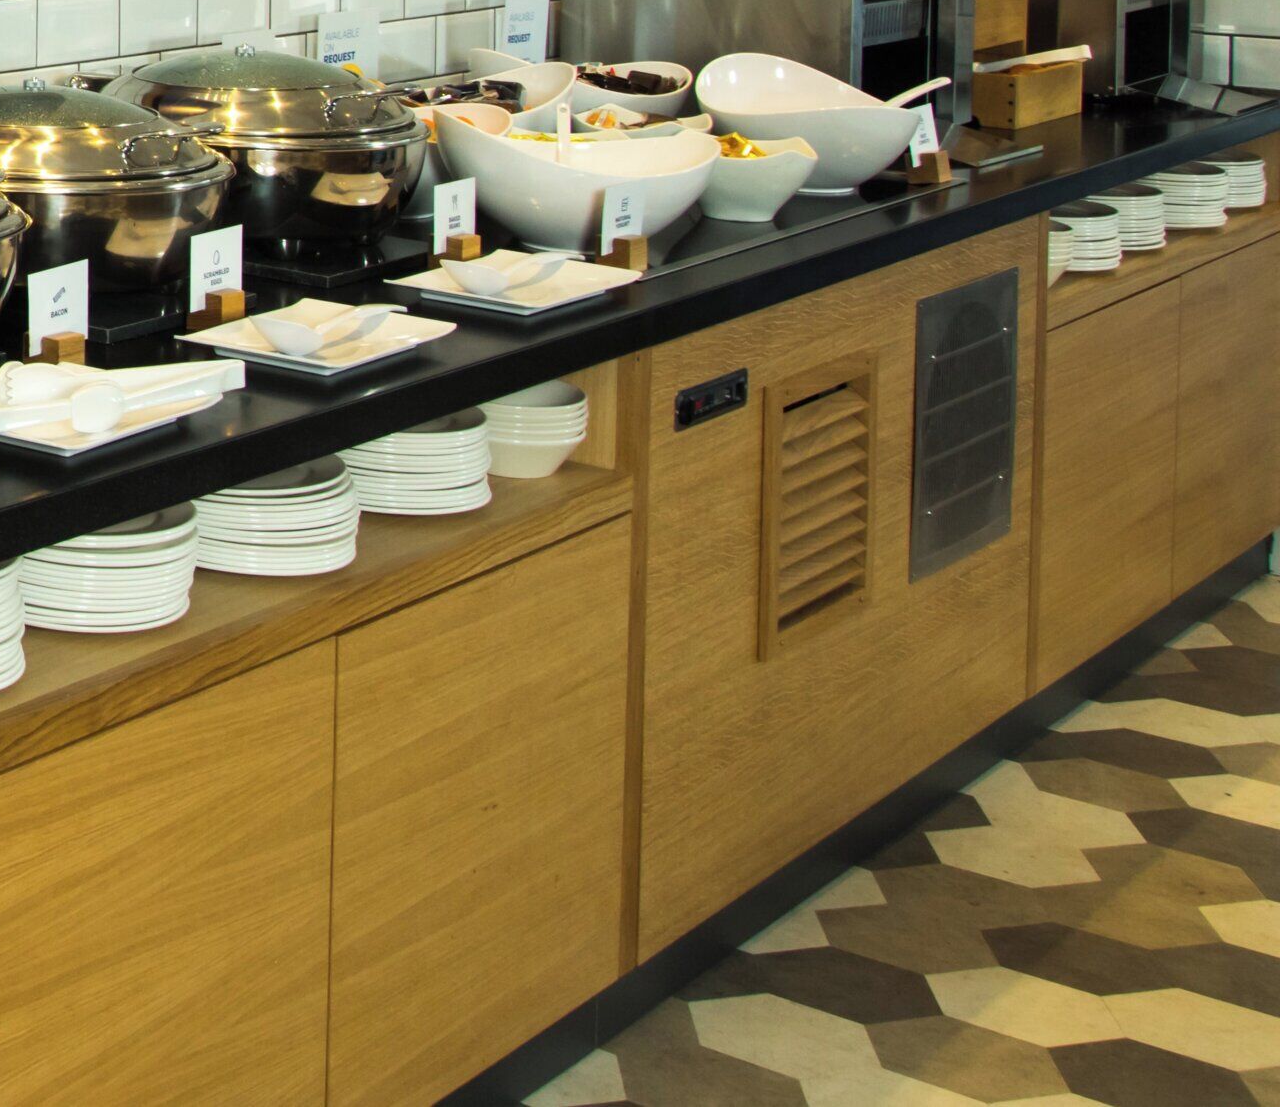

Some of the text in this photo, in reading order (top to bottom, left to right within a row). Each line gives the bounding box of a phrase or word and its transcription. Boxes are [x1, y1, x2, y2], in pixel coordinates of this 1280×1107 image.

[324, 27, 360, 41] AVAILABLE
[507, 33, 531, 44] REQUEST
[323, 51, 356, 64] REQUEST
[50, 307, 68, 319] BACON
